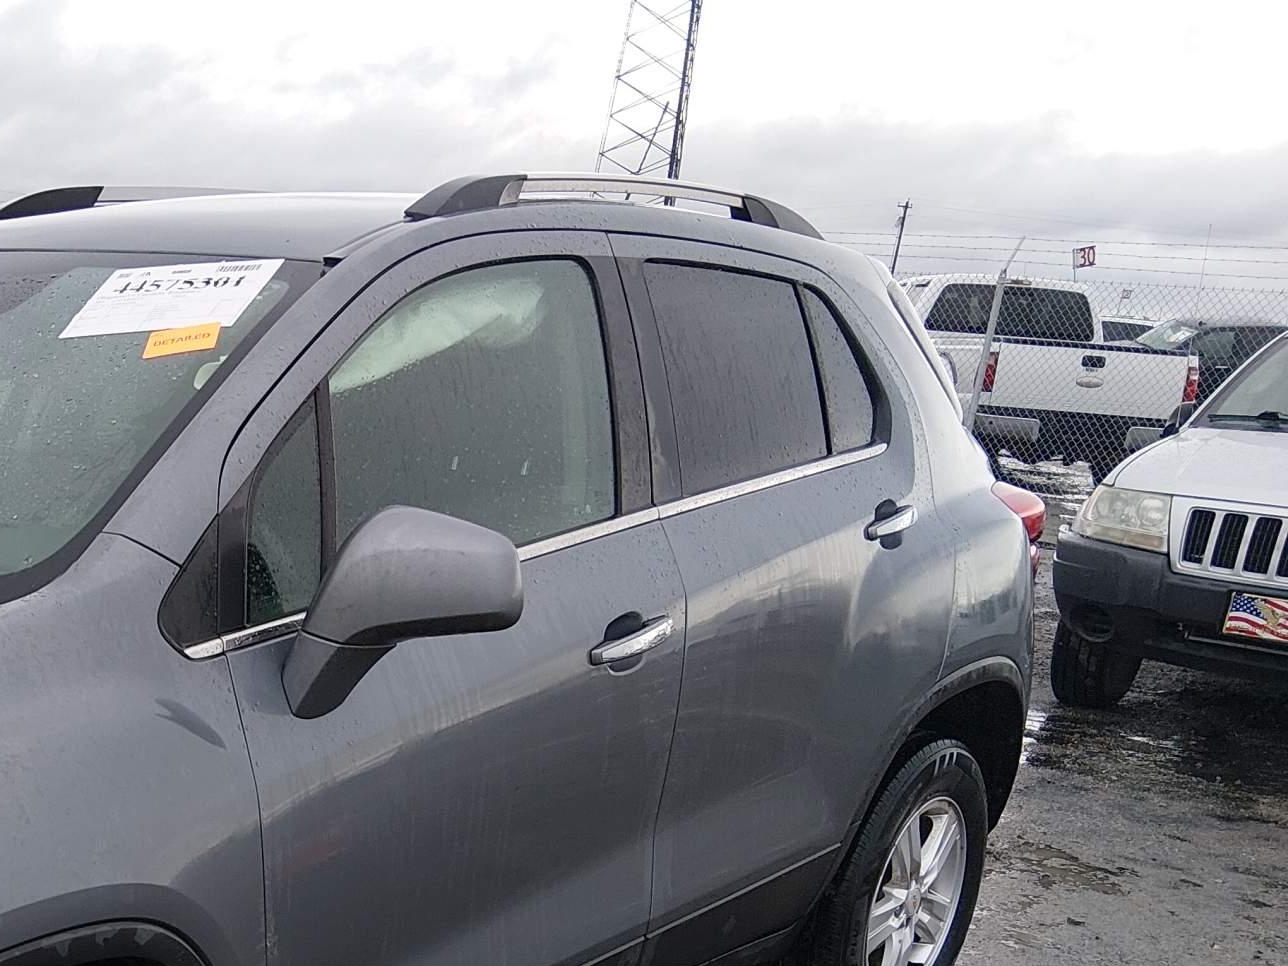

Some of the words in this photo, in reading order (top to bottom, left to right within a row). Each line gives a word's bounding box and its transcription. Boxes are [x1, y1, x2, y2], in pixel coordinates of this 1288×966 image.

[1079, 246, 1096, 266] 30
[113, 276, 246, 294] 44575301
[153, 333, 211, 347] DETAILED
